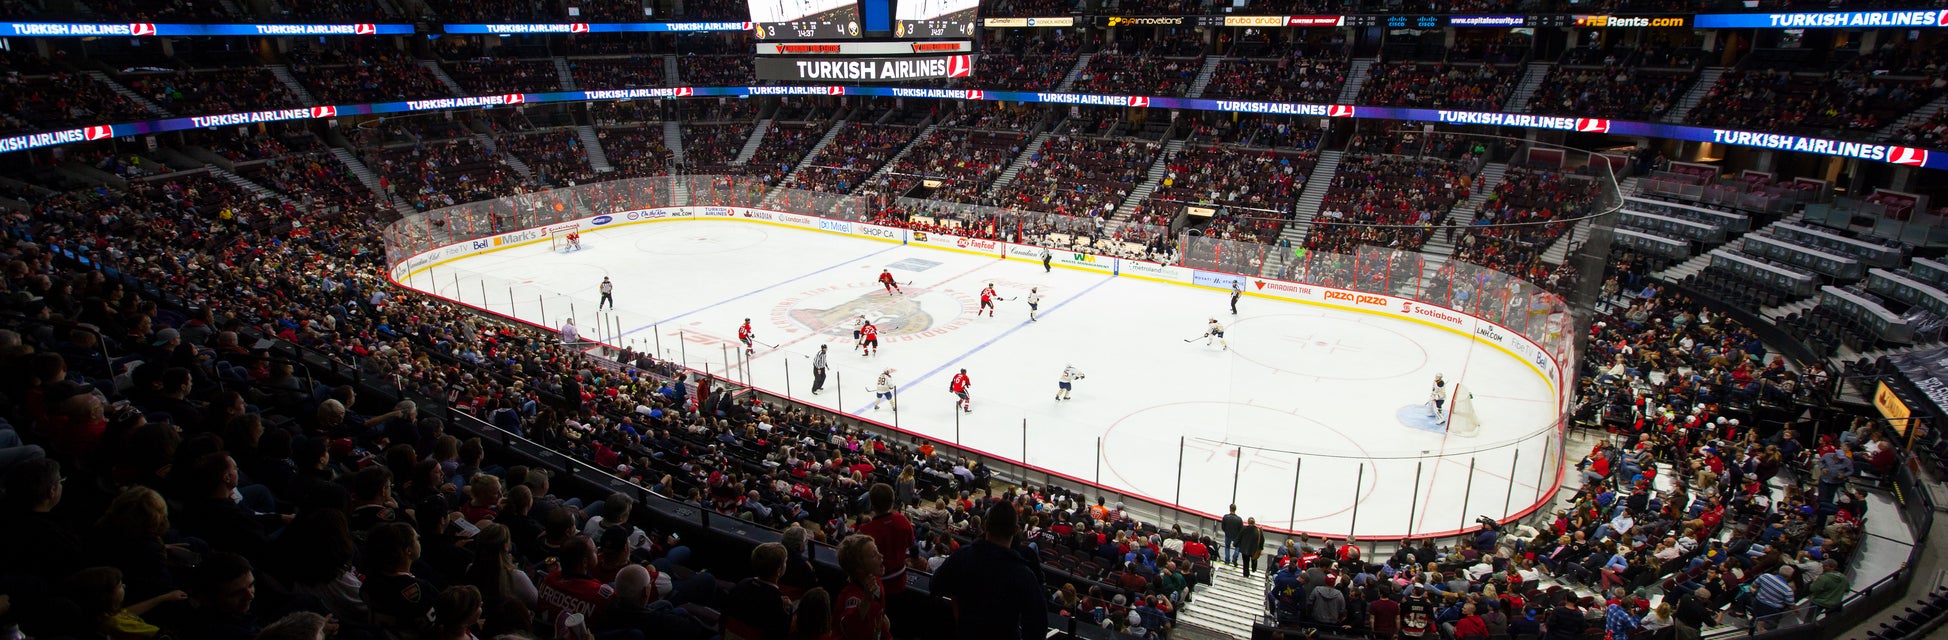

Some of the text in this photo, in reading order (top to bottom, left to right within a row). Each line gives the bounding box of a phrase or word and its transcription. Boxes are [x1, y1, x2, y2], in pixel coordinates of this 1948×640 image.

[1226, 16, 1251, 24] aruba
[1255, 16, 1281, 24] aruba
[1451, 16, 1523, 25] www.capitalsecurity.ca
[1770, 11, 1937, 27] TURKISH AIRLINES
[12, 24, 130, 34] TURKISH AIRLINES
[256, 25, 355, 34] TURKISH AIRLINES
[487, 24, 571, 33] TURKISH AIRLINES
[666, 23, 703, 31] TURKISH
[768, 24, 845, 36] 3 4
[908, 24, 914, 34] 3
[960, 24, 966, 34] 4
[797, 59, 946, 80] TURKISH AIRLINES
[585, 88, 674, 100] TURKISH AIRLINES
[748, 86, 827, 96] TURKISH AIRLINES
[892, 88, 965, 99] TURKISH AIRLINES
[408, 95, 503, 111] TURKISH AIRLINES
[1038, 92, 1126, 106] TURKISH AIRLINES
[1216, 101, 1326, 116] TURKISH AIRLINES
[192, 108, 310, 128] TURKISH AIRLINES
[1438, 111, 1575, 131] TURKISH AIRLINES
[29, 131, 83, 149] AIRLINES
[1713, 129, 1885, 159] TURKISH AIRLINES
[830, 220, 850, 232] Mitel
[502, 230, 536, 245] Mark's
[473, 239, 489, 250] Bell
[1074, 253, 1096, 263] WM
[1267, 282, 1312, 295] CANADIAN TIRE
[1324, 290, 1388, 307] pizza pizza
[1414, 306, 1463, 326] Scotiabank
[1476, 327, 1502, 342] LNH.COM
